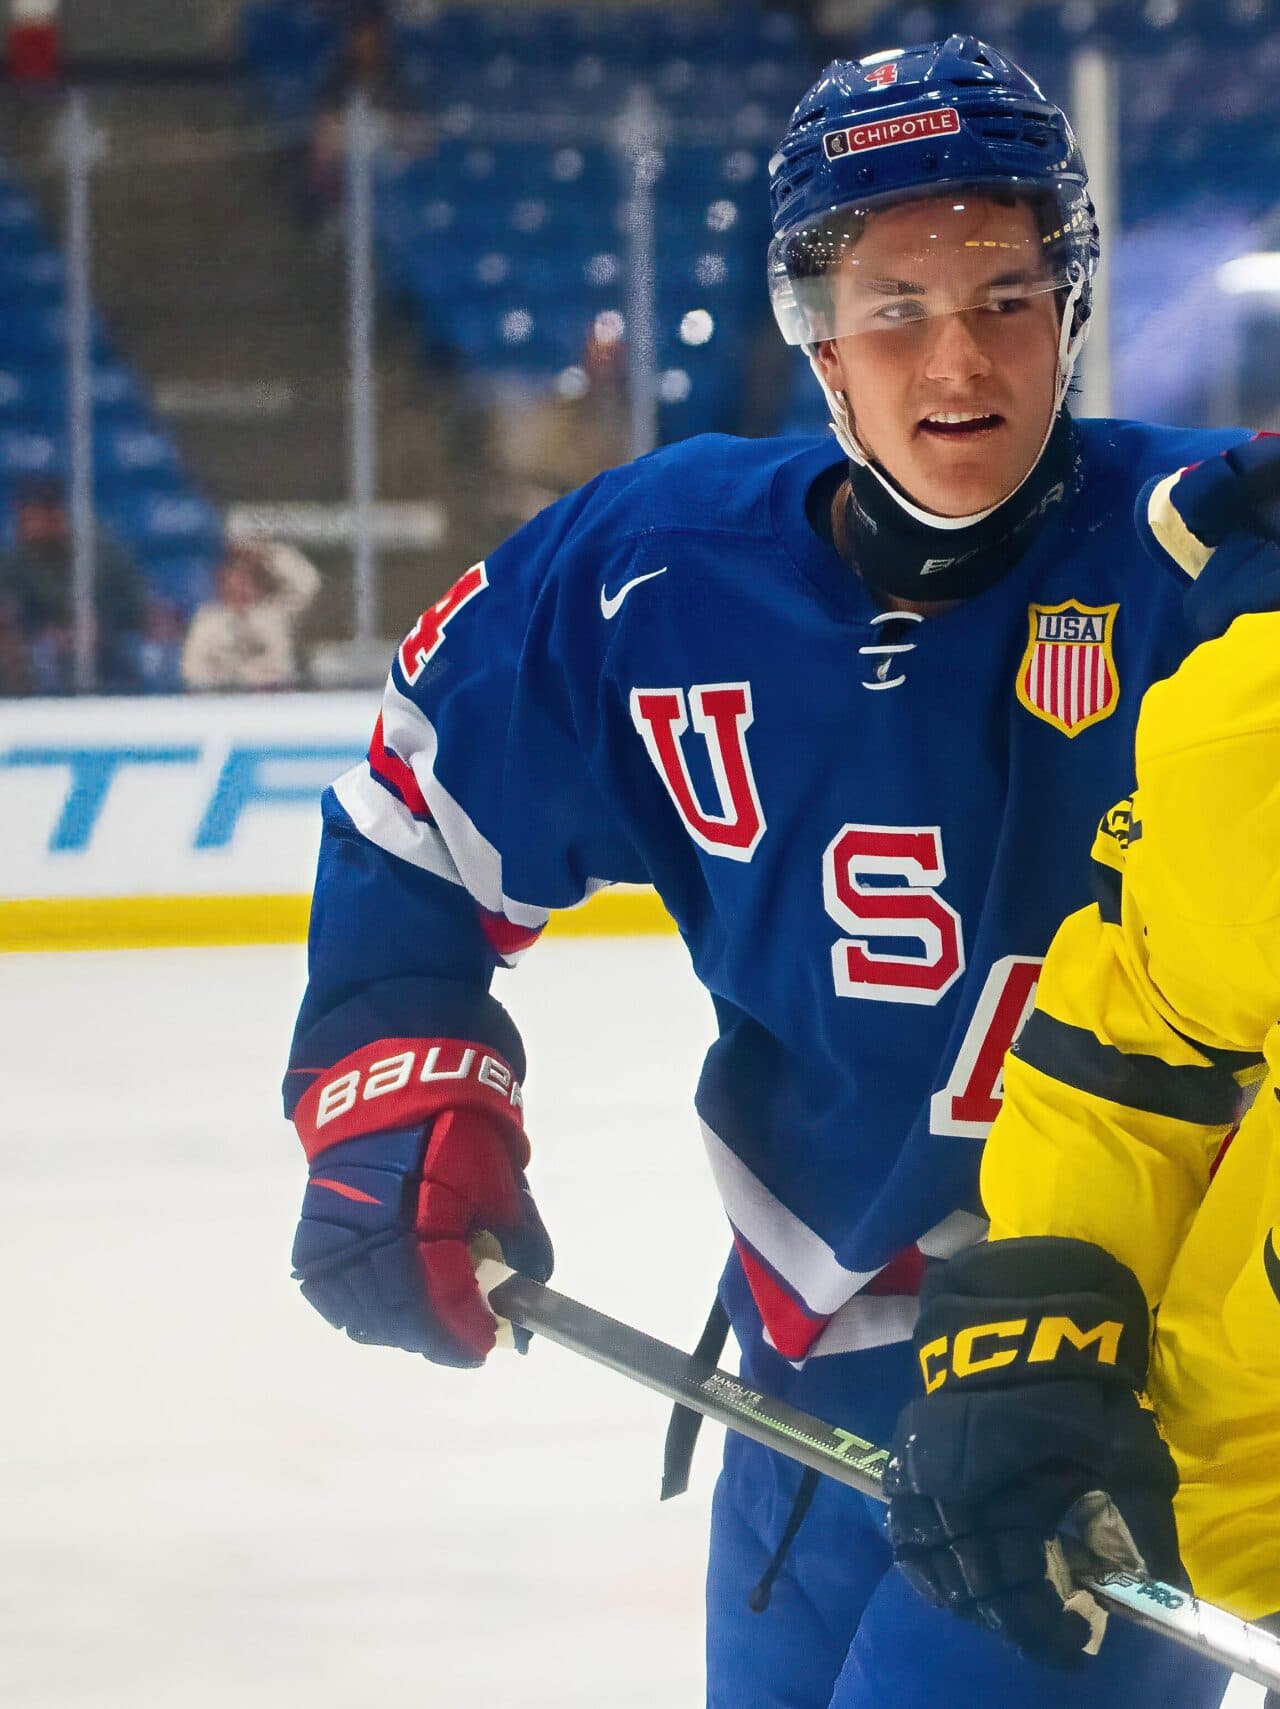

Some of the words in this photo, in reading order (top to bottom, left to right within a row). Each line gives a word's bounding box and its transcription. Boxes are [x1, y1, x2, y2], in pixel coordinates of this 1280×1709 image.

[864, 62, 899, 87] 4
[853, 112, 954, 145] CHIPOTLE
[398, 560, 489, 687] 4
[1045, 616, 1097, 640] USA
[918, 1315, 1125, 1396] CCM
